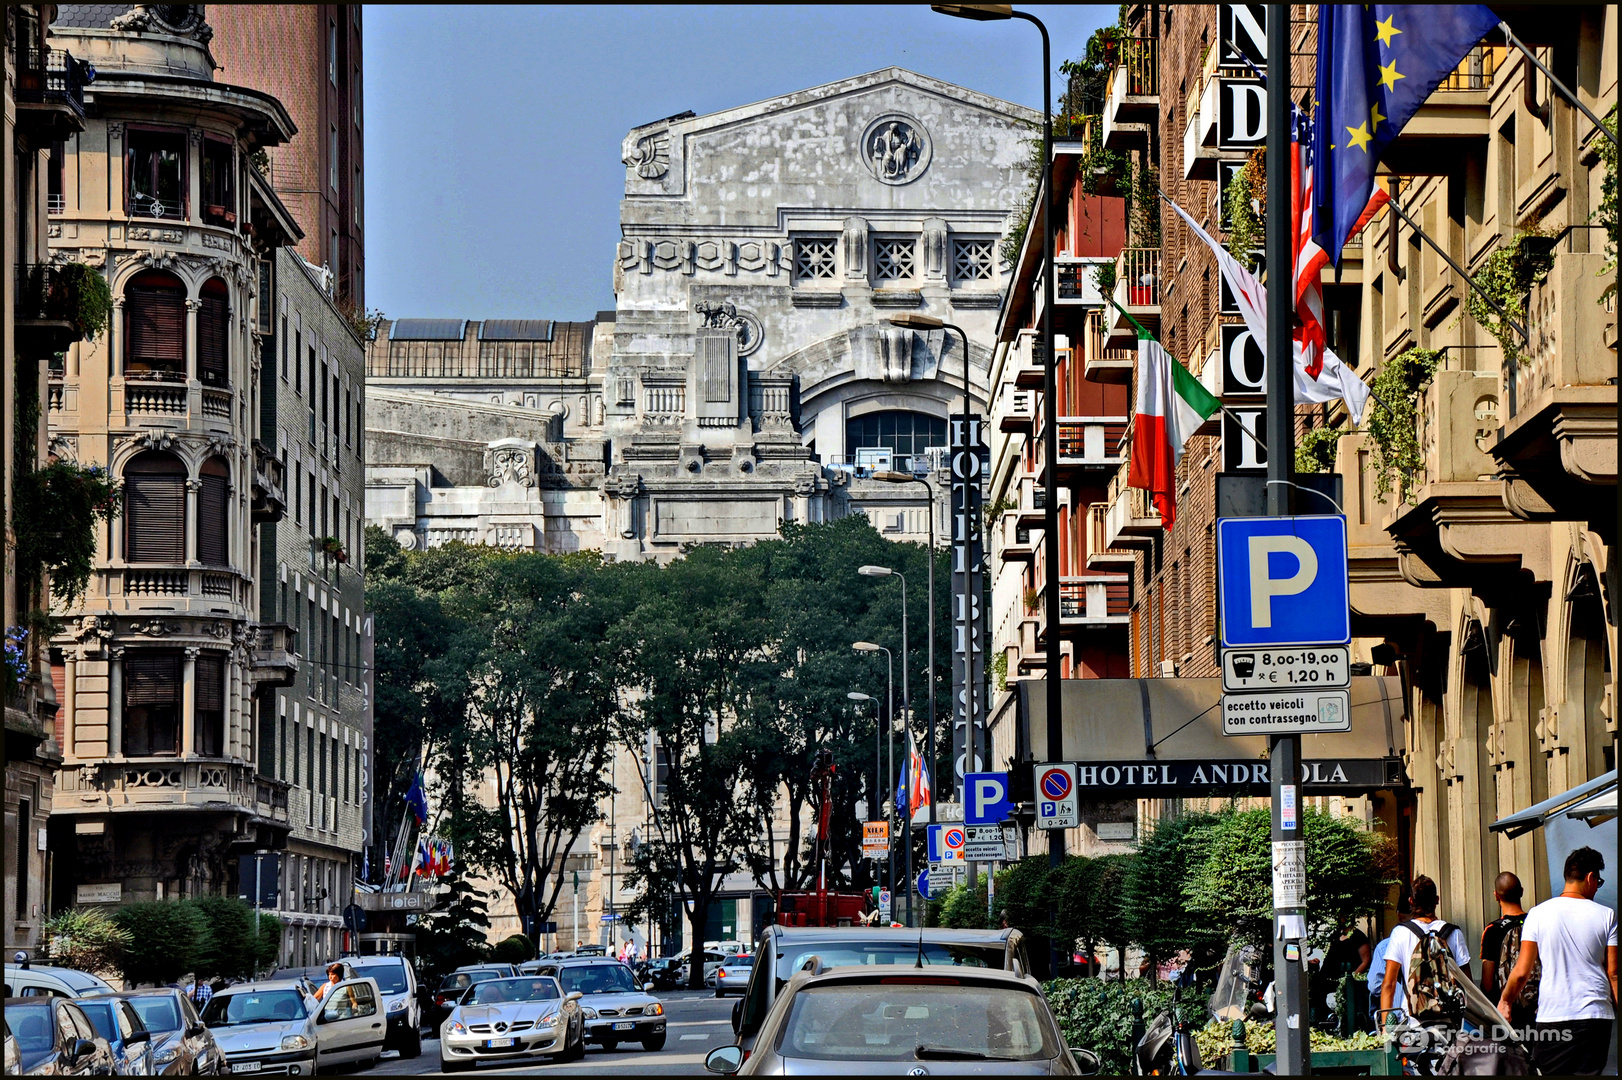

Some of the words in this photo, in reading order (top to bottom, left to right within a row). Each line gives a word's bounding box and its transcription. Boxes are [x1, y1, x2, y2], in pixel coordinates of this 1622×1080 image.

[951, 420, 980, 573] HOTEL
[1248, 535, 1318, 628] P
[1287, 670, 1318, 683] 1,20
[1227, 700, 1266, 711] eccetto
[1270, 698, 1304, 709] veicoli
[1228, 717, 1246, 725] con
[1249, 713, 1317, 725] contrassegno
[1079, 765, 1177, 786] HOTEL
[975, 780, 1004, 818] P
[1044, 804, 1053, 815] P
[383, 894, 420, 908] Hotel
